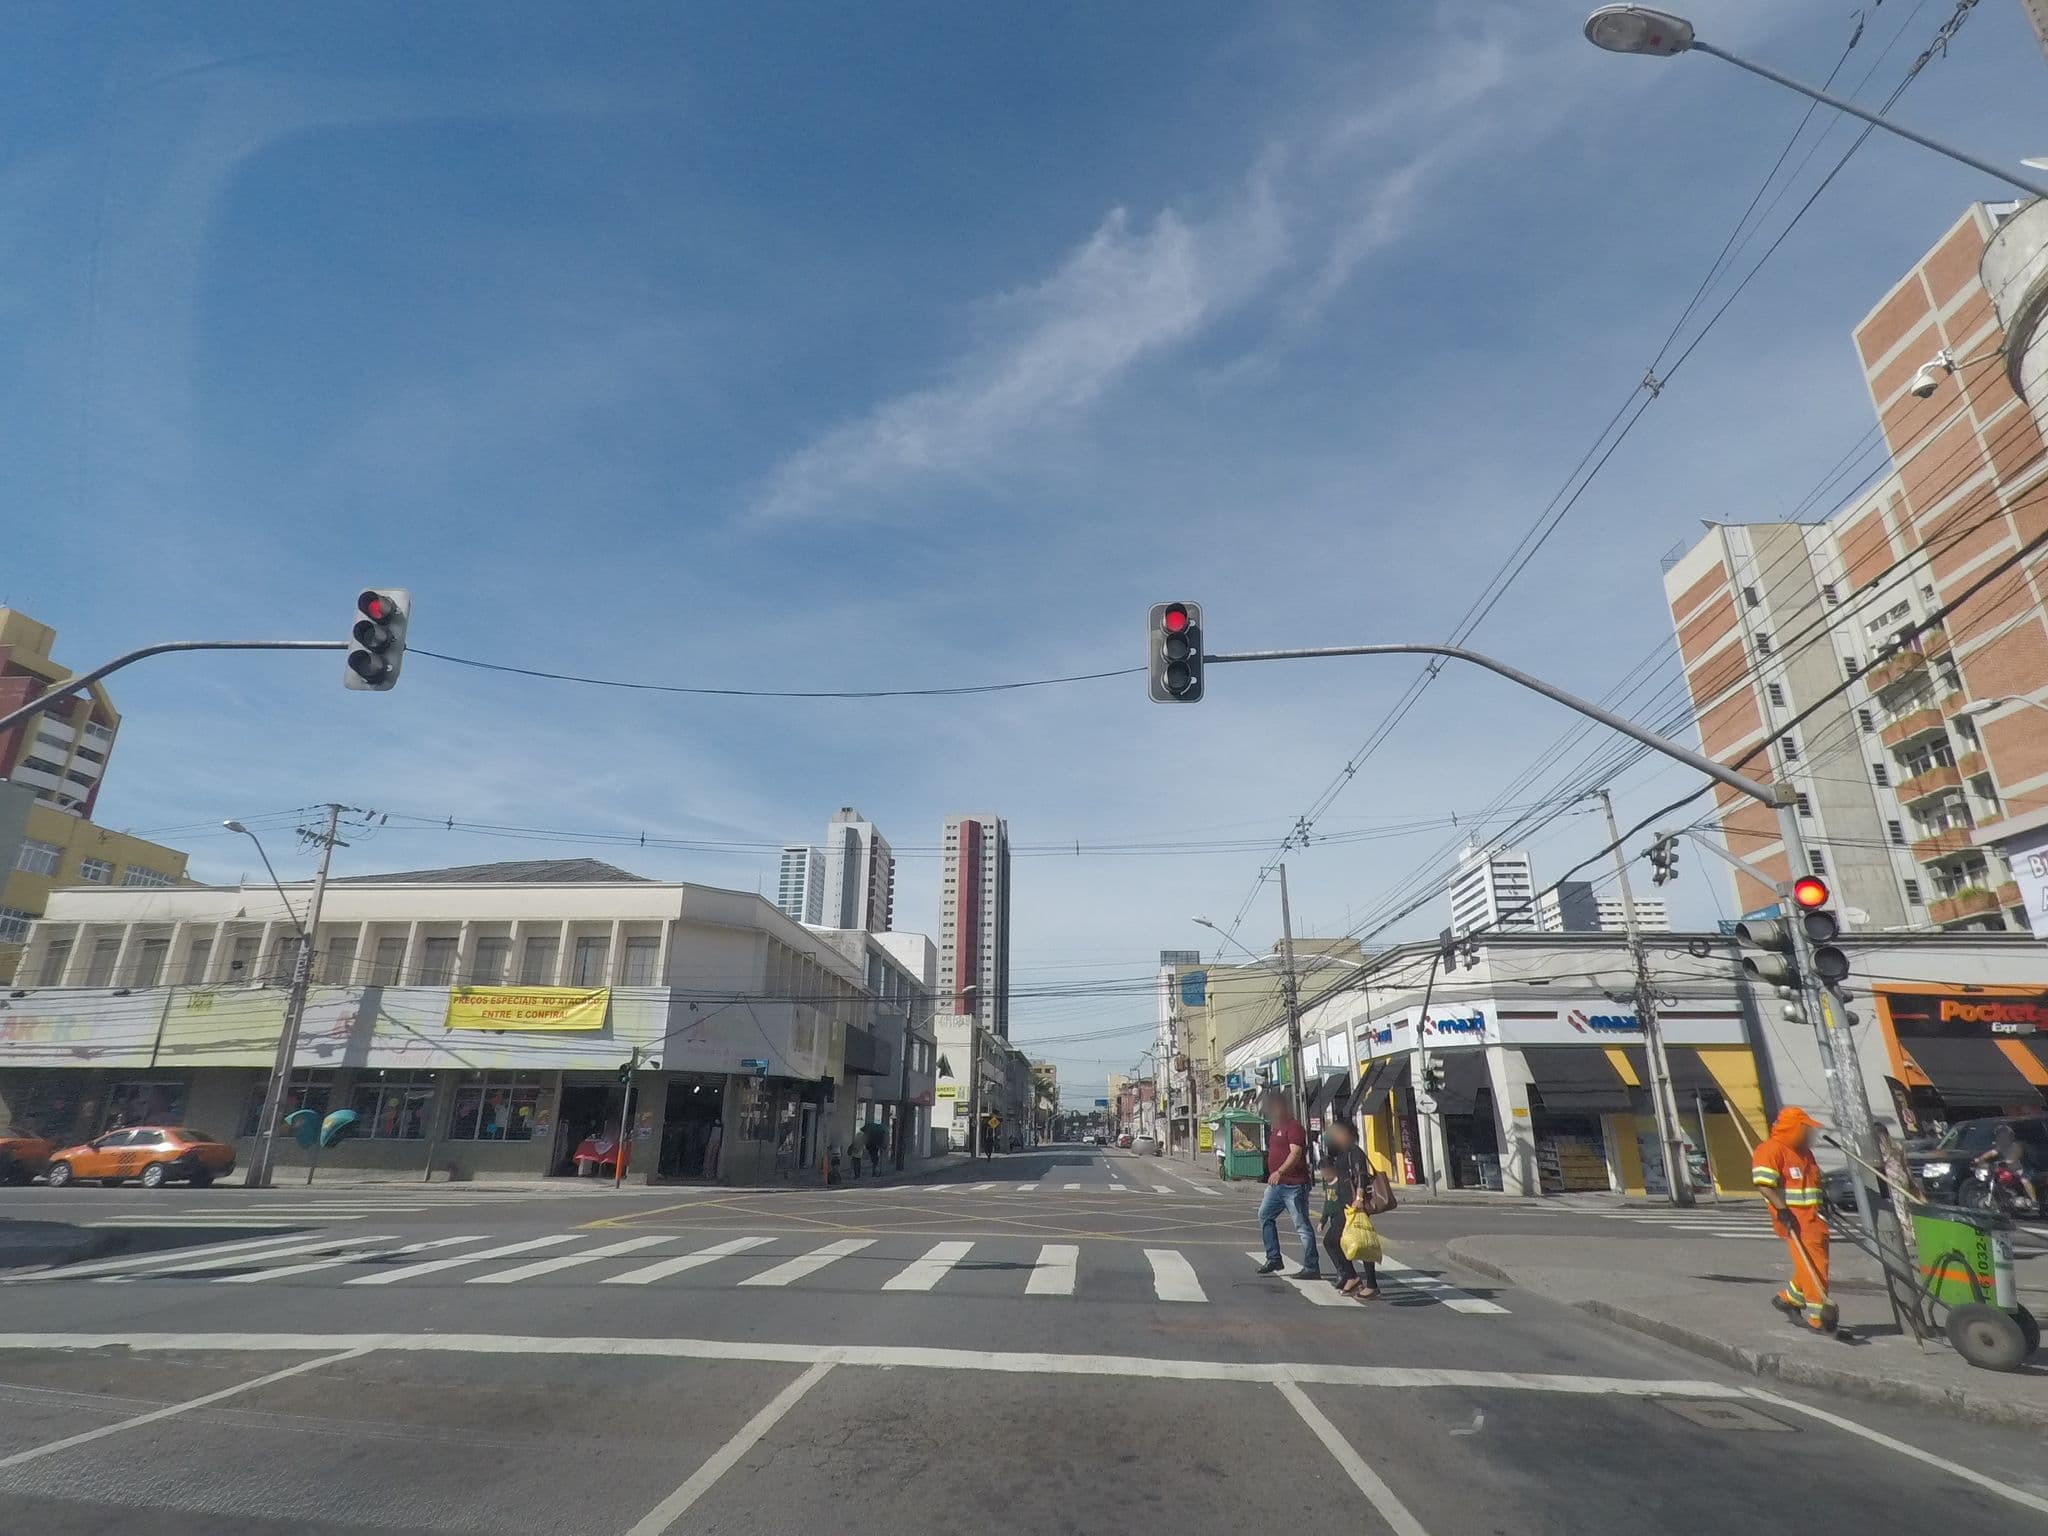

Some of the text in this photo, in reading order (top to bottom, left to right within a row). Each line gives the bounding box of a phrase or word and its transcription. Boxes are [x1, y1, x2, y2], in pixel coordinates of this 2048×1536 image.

[453, 996, 488, 1006] PREÇOS
[490, 996, 537, 1006] ESPECIAIS
[543, 997, 556, 1005] NO
[481, 1010, 512, 1018] ENTRE
[516, 1010, 523, 1019] E
[1400, 1120, 1416, 1180] FARMACIA
